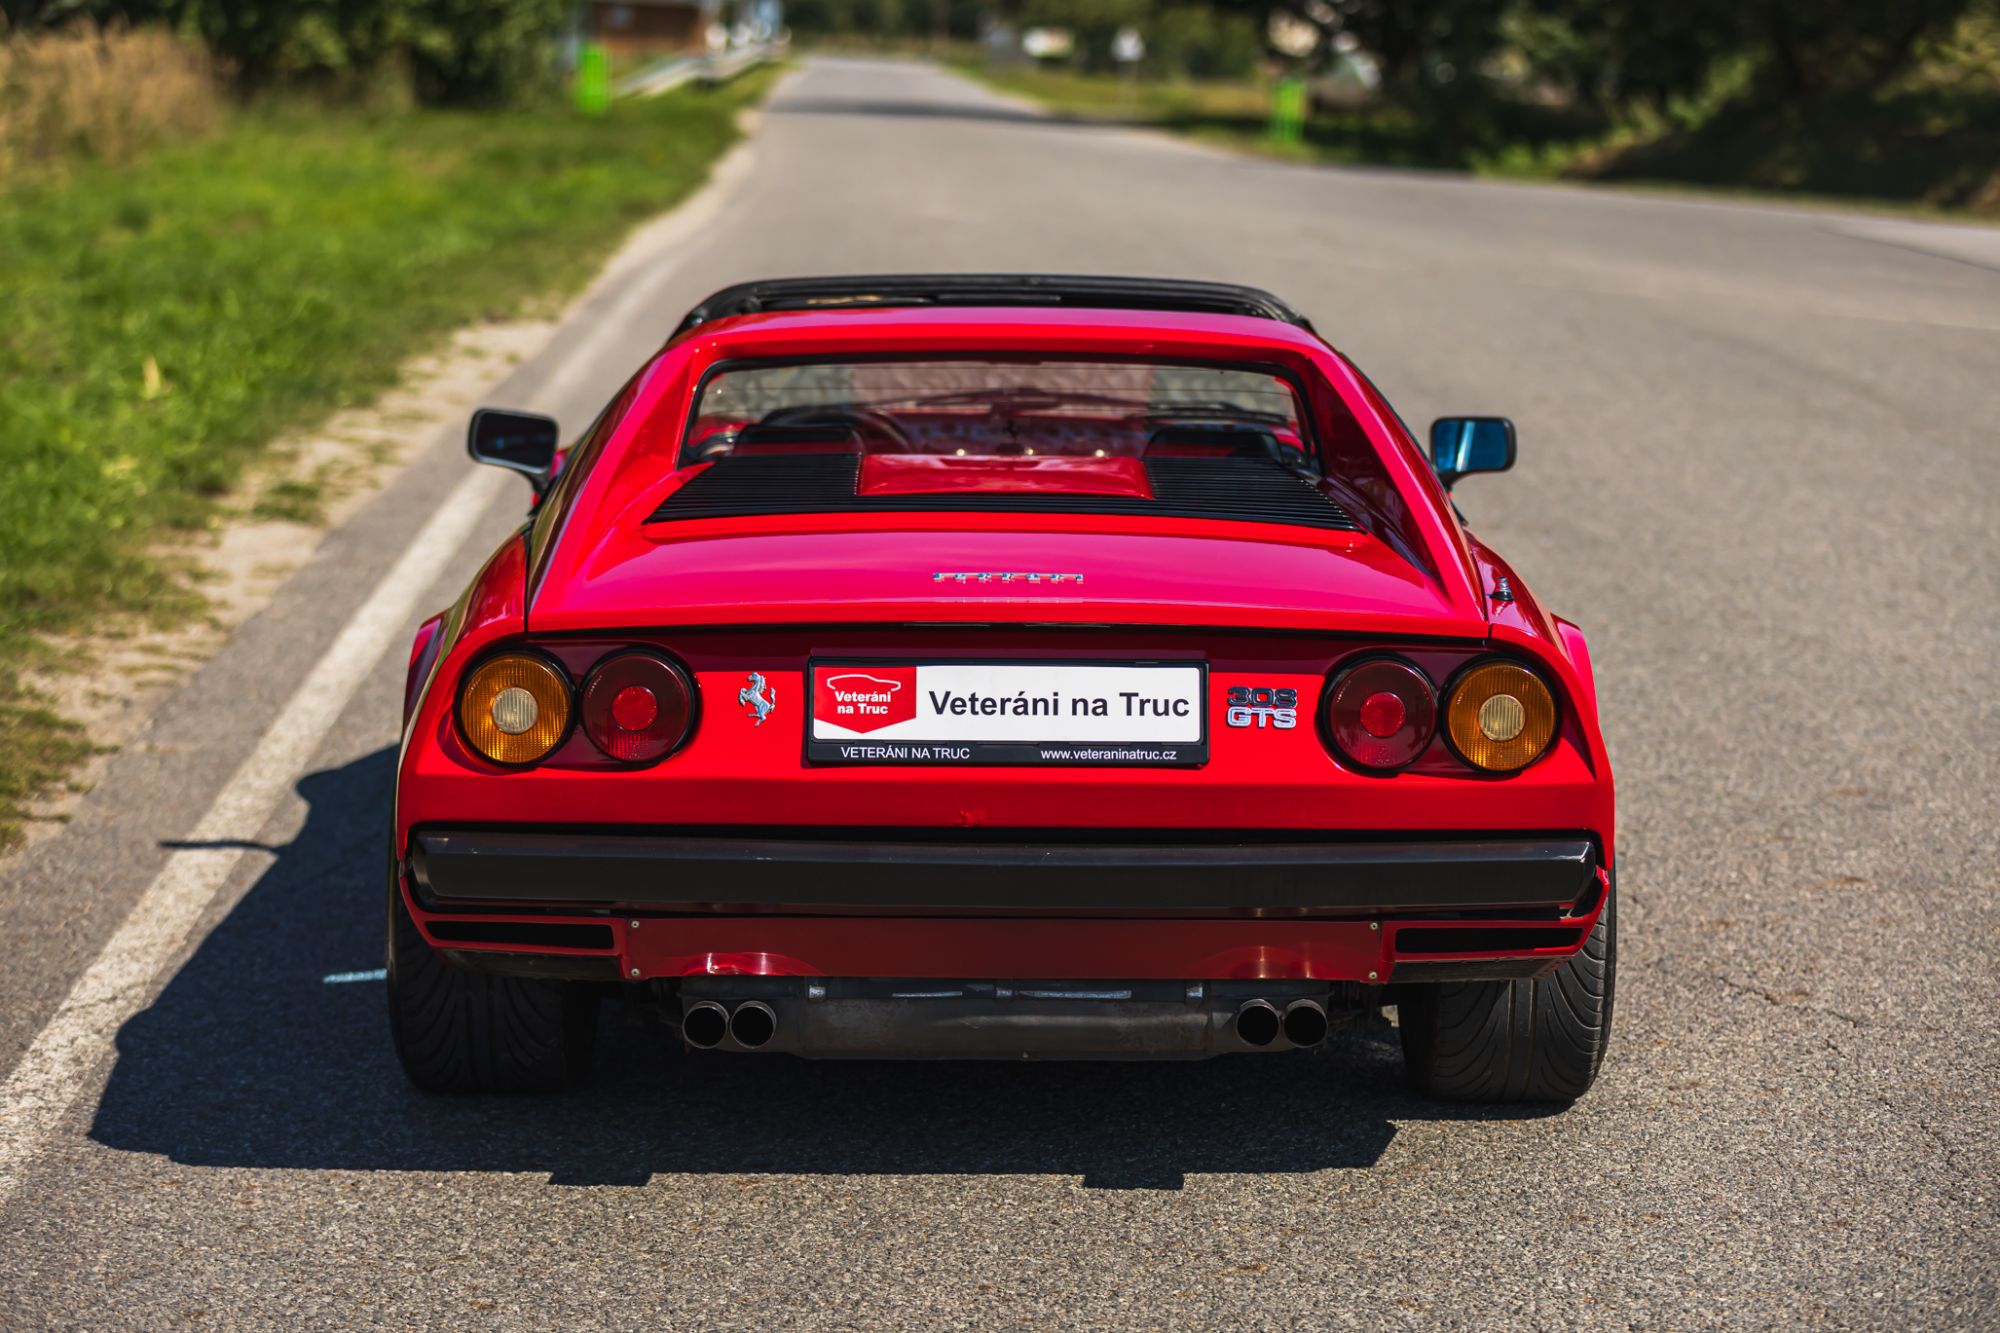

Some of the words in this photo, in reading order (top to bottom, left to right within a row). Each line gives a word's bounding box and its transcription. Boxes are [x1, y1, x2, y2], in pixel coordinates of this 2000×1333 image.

[834, 691, 892, 702] Veteráni
[1227, 686, 1298, 708] 308
[837, 705, 854, 714] na
[857, 703, 888, 714] Truc
[928, 690, 1059, 716] Veteráni
[1071, 698, 1108, 717] na
[1119, 692, 1190, 718] Truc
[1227, 706, 1297, 729] GTS
[841, 745, 908, 759] VETERÁNI
[911, 747, 930, 759] NA
[932, 747, 970, 759] TRUC
[1041, 748, 1176, 760] www.veteraninatruc.cz
